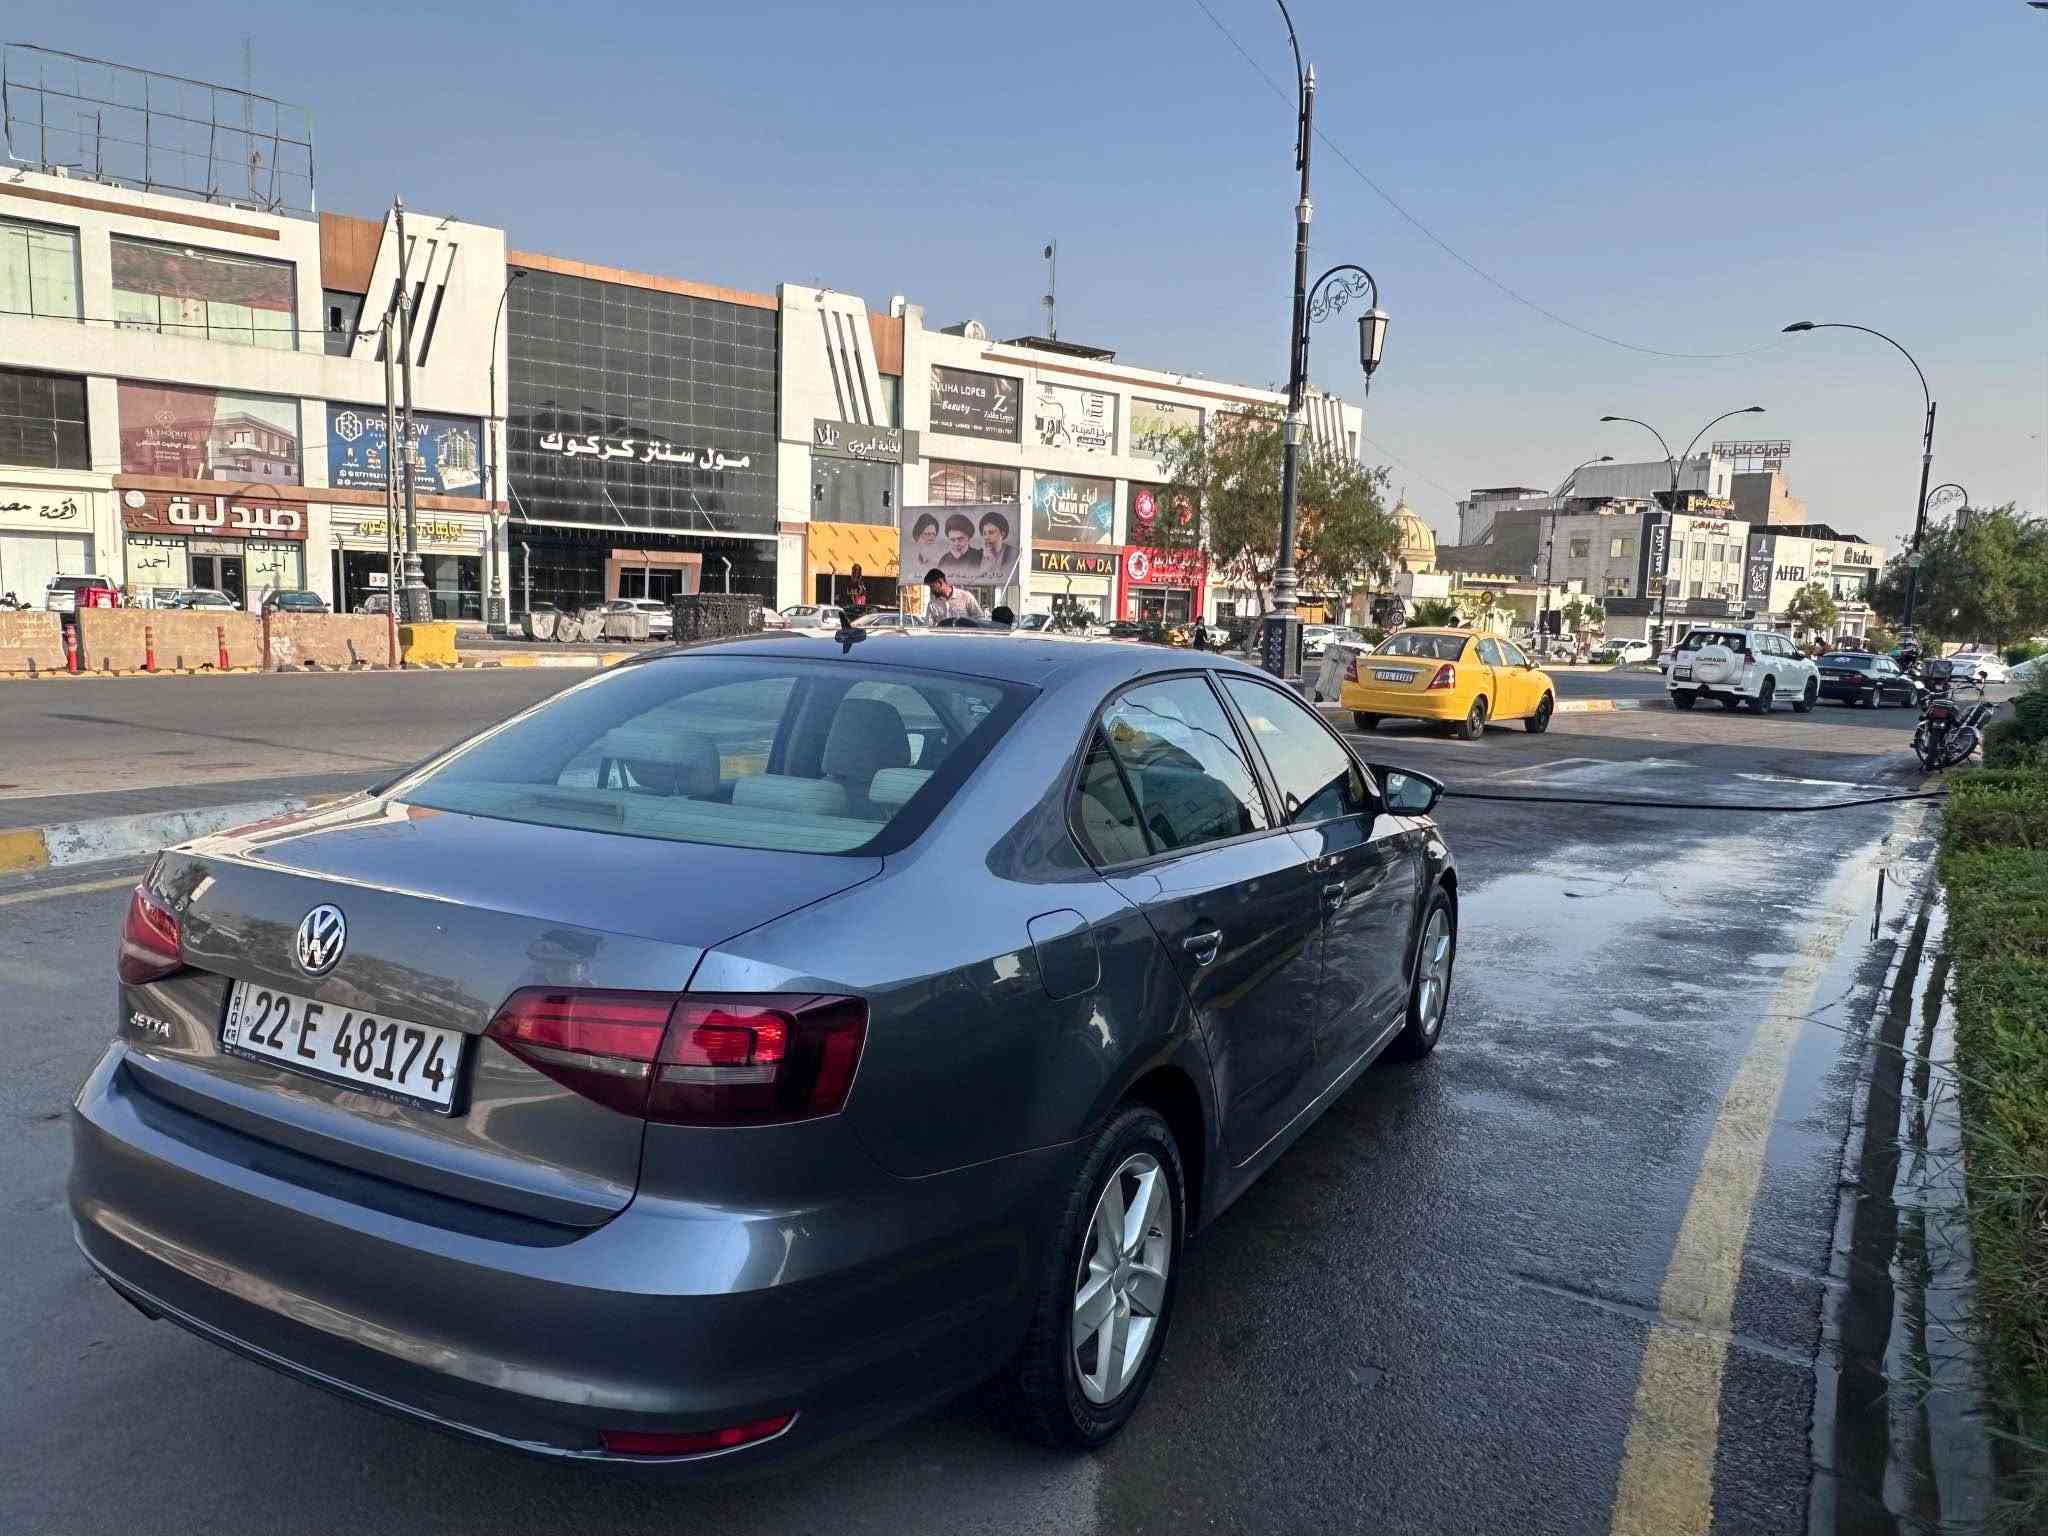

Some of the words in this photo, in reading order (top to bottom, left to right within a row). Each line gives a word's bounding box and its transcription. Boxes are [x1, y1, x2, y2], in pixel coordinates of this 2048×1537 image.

[540, 432, 634, 460] كركوك
[639, 441, 695, 462] سنتر
[699, 447, 750, 470] مول
[168, 496, 301, 537] صيدلية
[1040, 552, 1071, 571] TAK
[1076, 558, 1112, 574] MDA
[130, 1011, 170, 1038] JETTA
[249, 991, 290, 1049] 22
[298, 1003, 324, 1060] E
[333, 1012, 444, 1092] 48174
